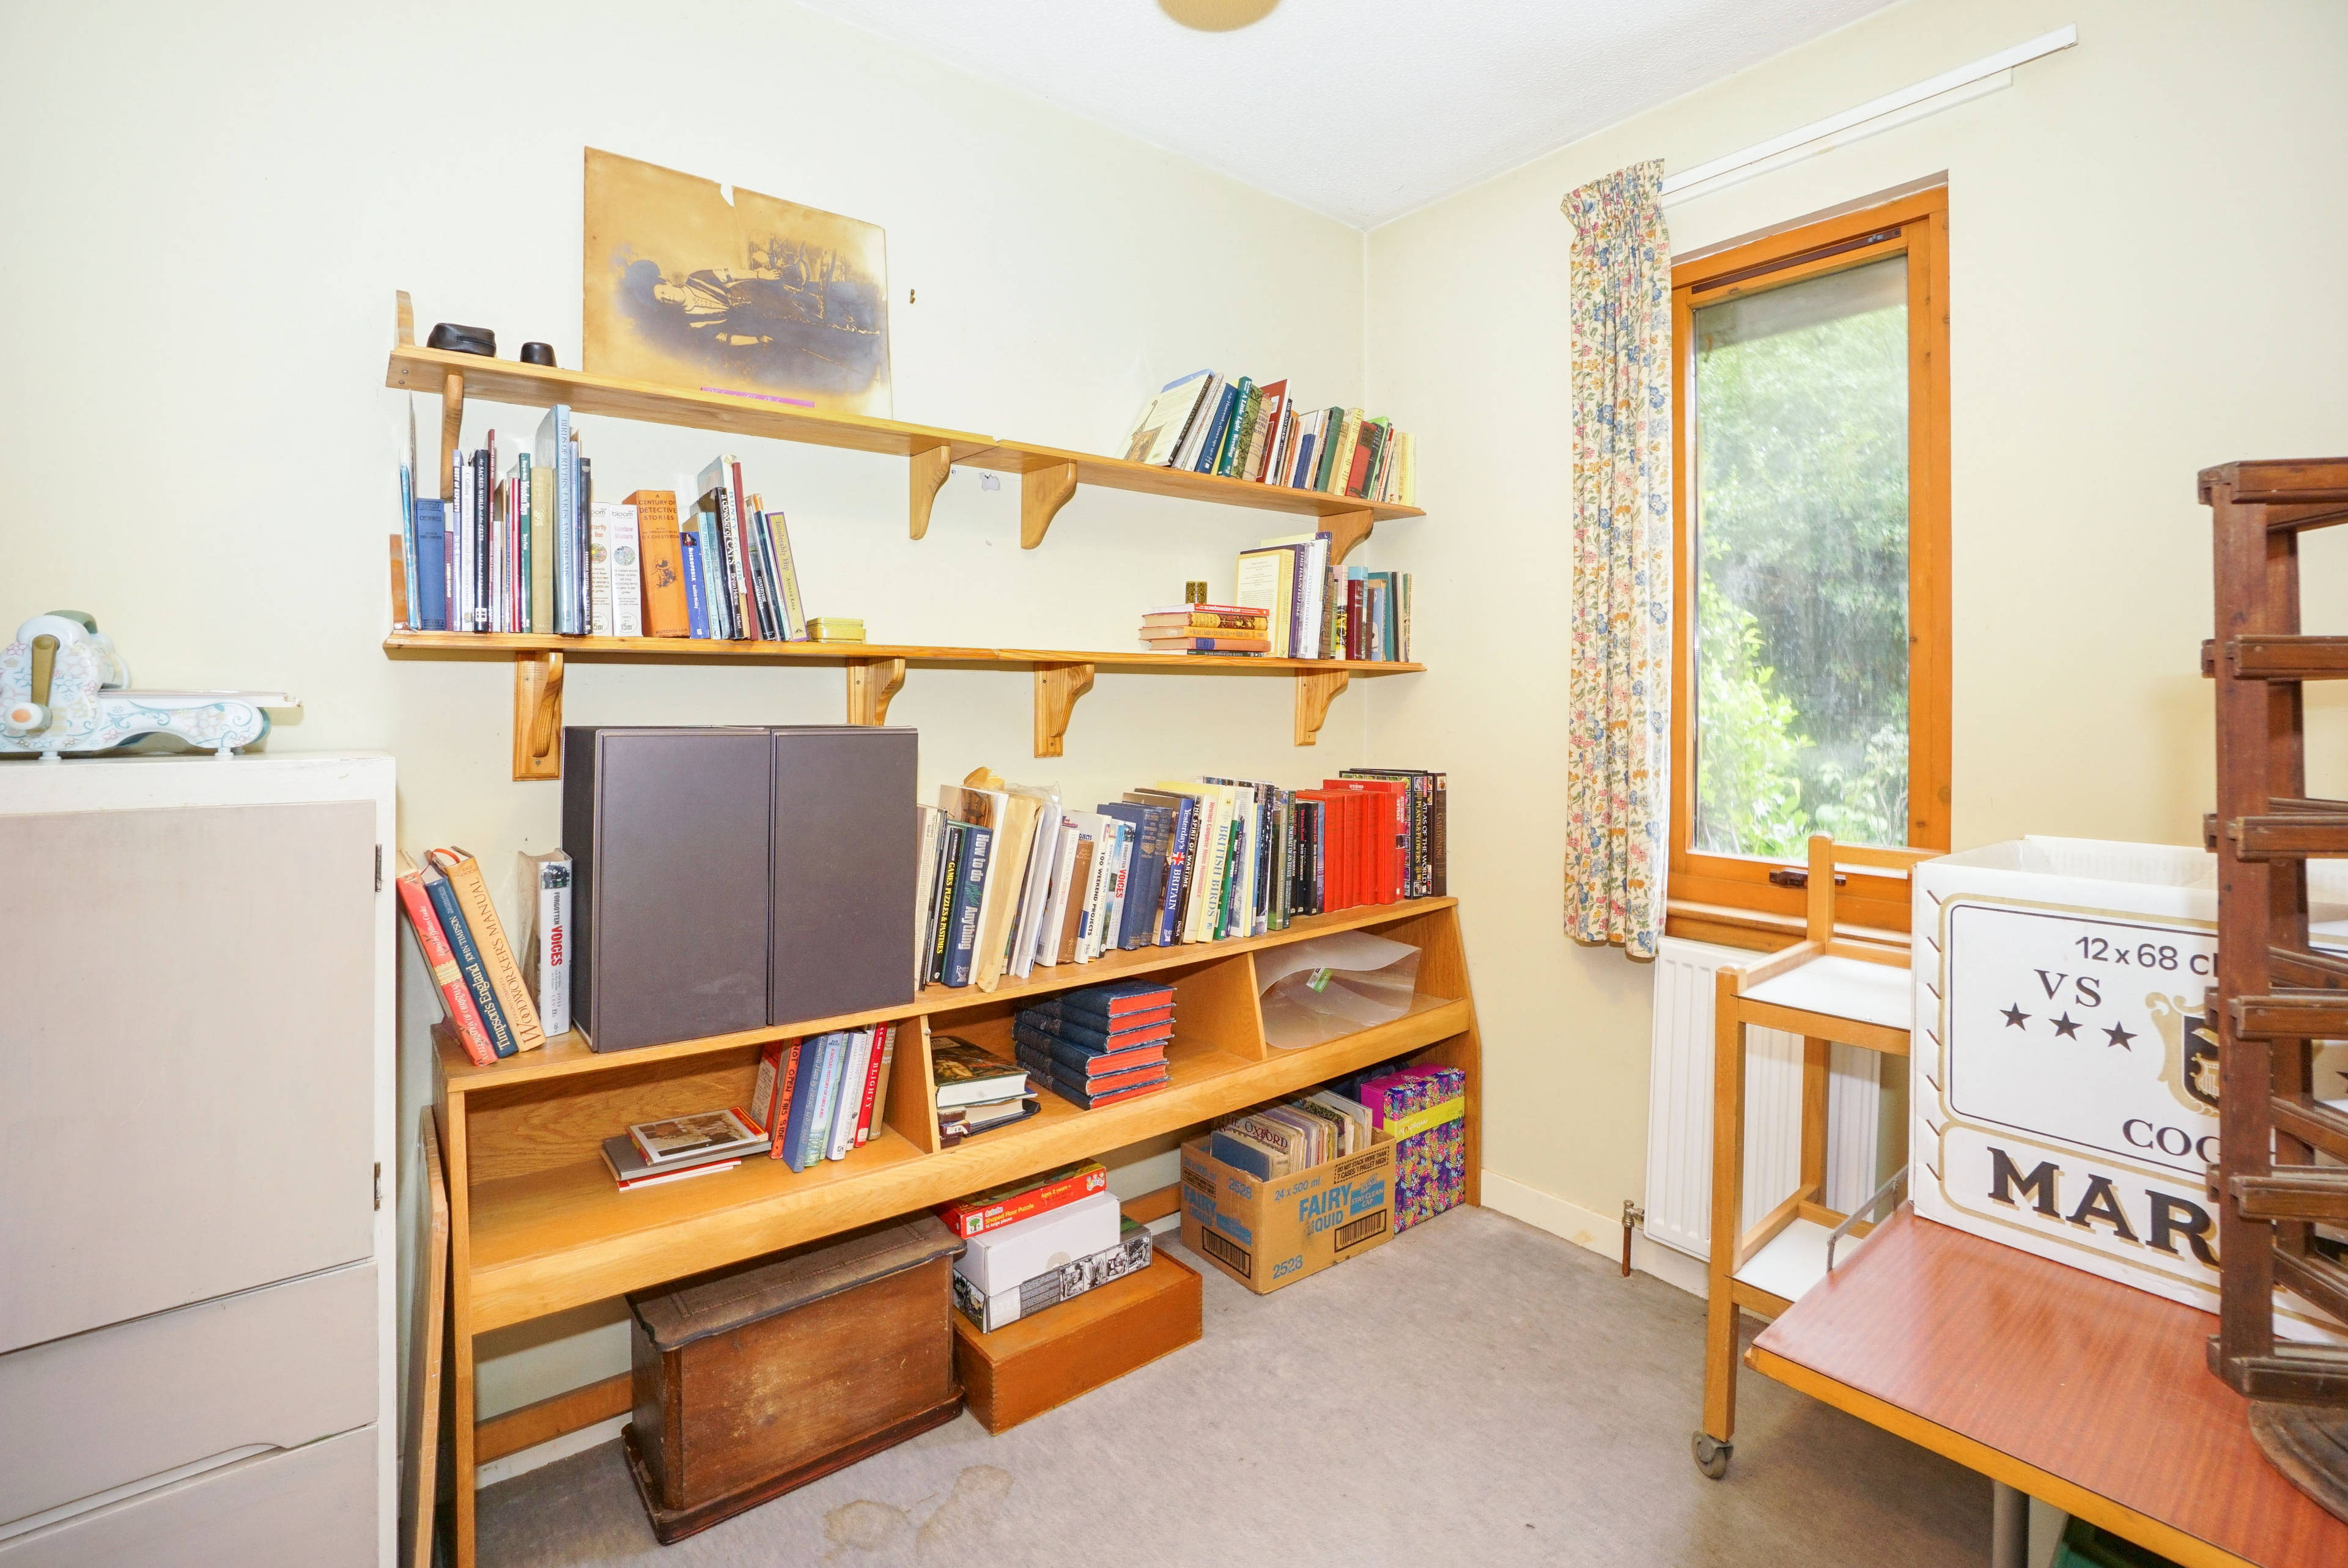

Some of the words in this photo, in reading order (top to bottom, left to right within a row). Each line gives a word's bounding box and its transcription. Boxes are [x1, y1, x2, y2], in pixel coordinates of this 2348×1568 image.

[1233, 415, 1242, 431] Light
[561, 444, 567, 455] OF
[1227, 432, 1238, 458] Weeding
[521, 480, 530, 502] Wooden
[722, 501, 731, 530] clowder
[729, 491, 738, 529] BUNTY
[776, 521, 787, 556] Intolerably
[725, 540, 736, 565] CATS
[1206, 801, 1216, 823] Newnes
[1178, 808, 1191, 850] Yesterday's
[1189, 819, 1198, 840] SPIRIT
[1202, 823, 1213, 848] Complete
[1422, 825, 1427, 836] OF
[974, 834, 989, 856] How
[1188, 842, 1194, 852] OF
[1200, 848, 1209, 864] Home
[1212, 825, 1229, 875] BRITISH
[945, 861, 955, 886] GAMES
[970, 869, 983, 882] do
[972, 858, 986, 868] to
[1182, 854, 1192, 888] WARTIME
[1092, 867, 1102, 901] WEEKEND
[1101, 867, 1110, 893] WOODEN
[1115, 868, 1126, 899] VOICES
[1168, 869, 1181, 910] BRITAIN
[1194, 865, 1207, 898] Maintenance
[469, 877, 499, 937] MANUAL
[941, 887, 952, 916] PUZZLES
[1206, 879, 1220, 917] BIRDS
[417, 904, 431, 921] Cooke
[1087, 903, 1096, 936] PROJECTS
[424, 918, 438, 936] Gillian
[449, 916, 465, 944] TIMPSON
[936, 922, 947, 954] PASTIMES
[958, 906, 978, 950] Anything
[462, 944, 475, 962] JOHN
[550, 925, 563, 966] VOICES
[2075, 937, 2109, 963] 12
[2114, 948, 2130, 965] x
[2136, 944, 2179, 971] 68
[465, 963, 492, 1003] England
[492, 938, 542, 1044] WOODWORKER'S
[451, 982, 467, 1012] CHRISTMAS
[462, 1012, 473, 1022] OF
[507, 1001, 519, 1022] COLLINS
[464, 1018, 488, 1055] CELEBRATION
[482, 1001, 511, 1051] Timpson's
[791, 1042, 800, 1064] NOT
[785, 1069, 796, 1092] OPEN
[867, 1062, 879, 1109] BLIGHTY
[781, 1095, 791, 1116] THIS
[818, 1095, 827, 1119] ENGLAND
[776, 1119, 786, 1141] SIDE
[1245, 1121, 1288, 1149] OXFORD
[1342, 1168, 1354, 1178] CASES
[1360, 1161, 1374, 1171] PALLET
[1056, 1185, 1068, 1194] years
[1228, 1177, 1252, 1199] 2528
[1275, 1188, 1284, 1201] 24
[1293, 1180, 1308, 1195] 500
[1311, 1176, 1321, 1188] ml
[1351, 1193, 1364, 1205] STAY
[1364, 1188, 1384, 1199] CLEAN
[985, 1213, 1005, 1224] Shaped
[1005, 1207, 1017, 1218] Floor
[1018, 1203, 1035, 1213] Puzzle
[1299, 1182, 1352, 1223] FAIRY
[1362, 1199, 1373, 1207] CAP
[1001, 1216, 1013, 1225] pieces
[1307, 1211, 1343, 1236] LIQUID
[1272, 1255, 1302, 1279] 2528
